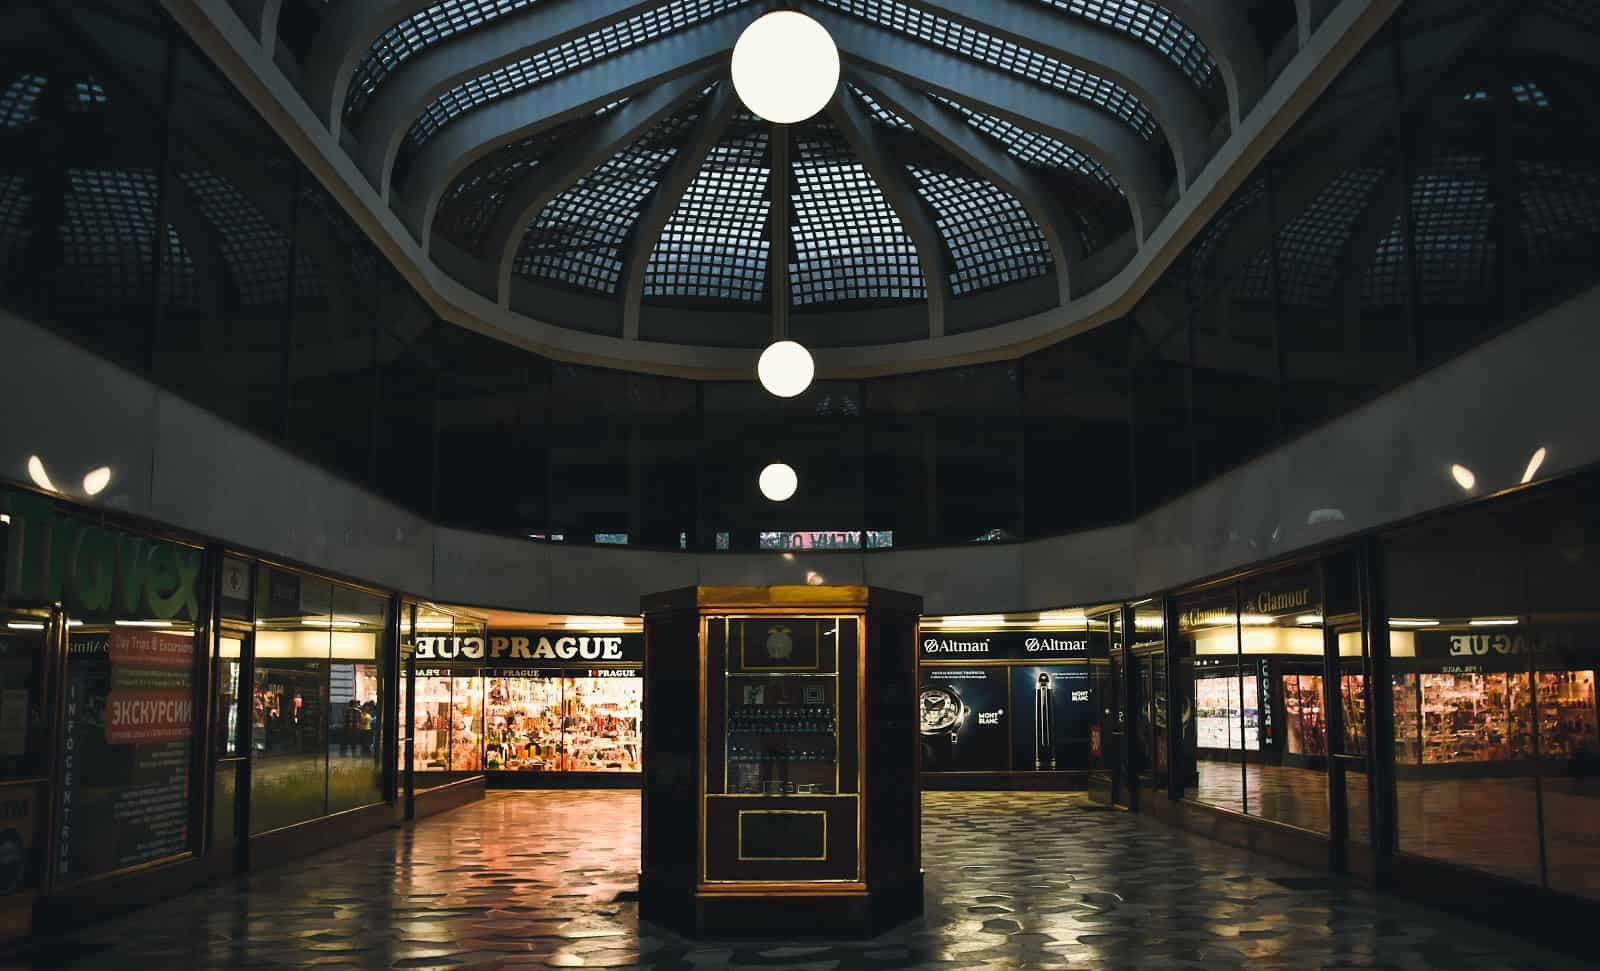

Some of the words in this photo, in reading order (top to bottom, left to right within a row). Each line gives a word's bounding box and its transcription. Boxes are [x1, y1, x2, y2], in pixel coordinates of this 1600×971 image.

[490, 636, 623, 660] PRAGUE
[938, 638, 989, 653] Altman
[597, 669, 636, 677] PRAGUE
[111, 698, 193, 726] ЭКСКУРСИИ
